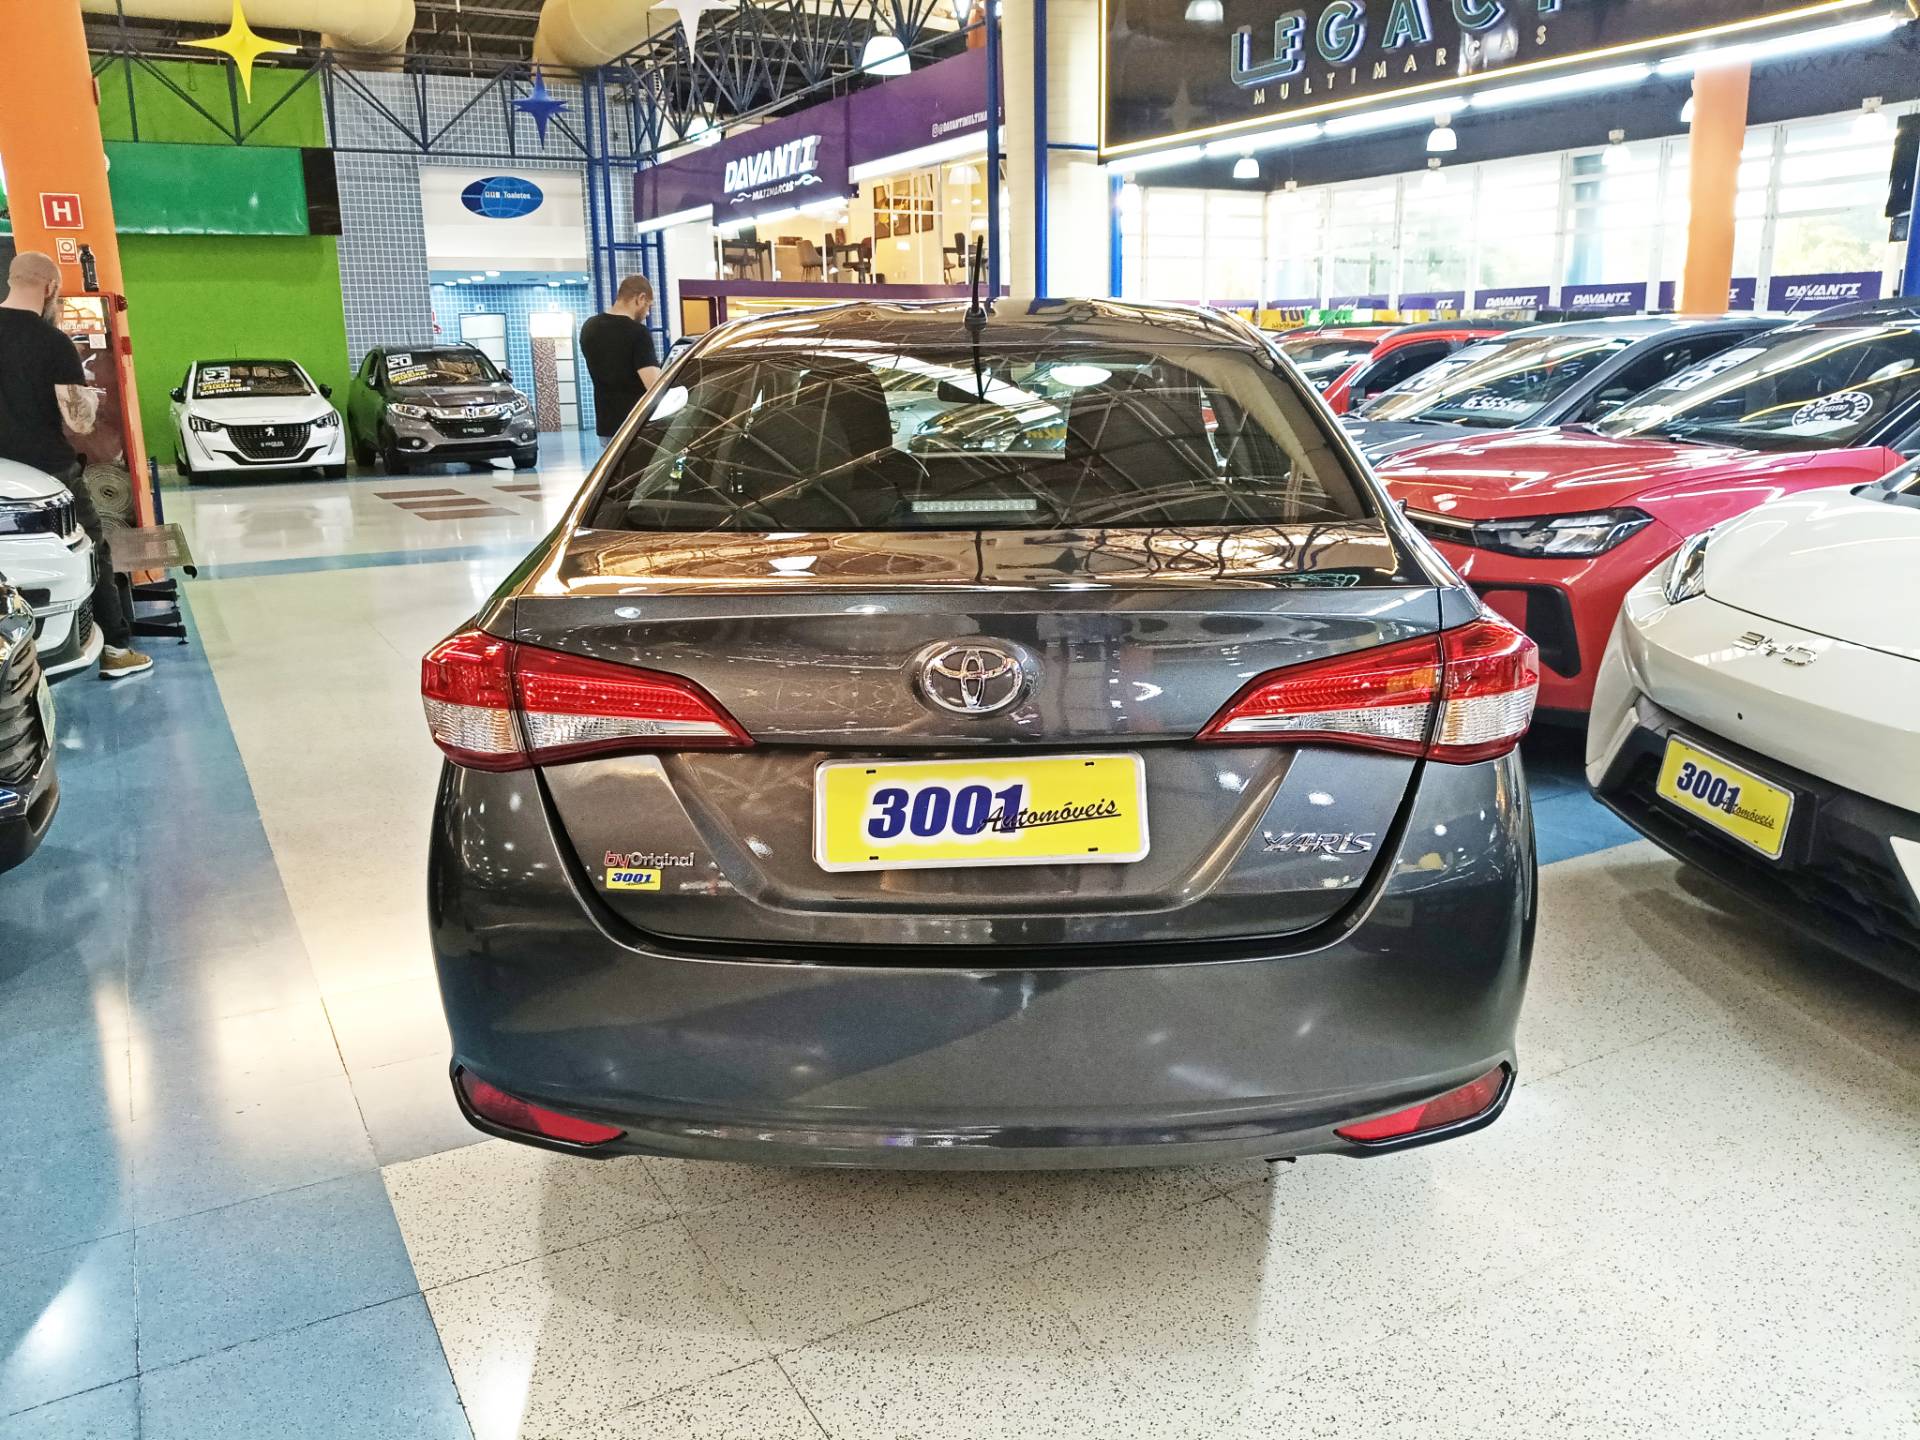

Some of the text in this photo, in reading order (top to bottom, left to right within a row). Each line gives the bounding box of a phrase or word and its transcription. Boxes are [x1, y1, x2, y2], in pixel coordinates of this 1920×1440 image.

[1231, 0, 1562, 85] LEGAC
[1253, 25, 1548, 105] MULTIMARCAS
[723, 135, 822, 193] DAVANTI
[752, 181, 795, 201] MULTIMARCAS
[52, 201, 72, 221] H
[1573, 292, 1632, 305] DAVANTI
[1785, 283, 1862, 297] DAVANTI
[1485, 295, 1538, 307] DAVANTI
[1677, 761, 1741, 815] 3001
[867, 784, 1120, 839] 3001 Automóveis
[1262, 831, 1377, 854] YARIS
[612, 872, 652, 884] 3001
